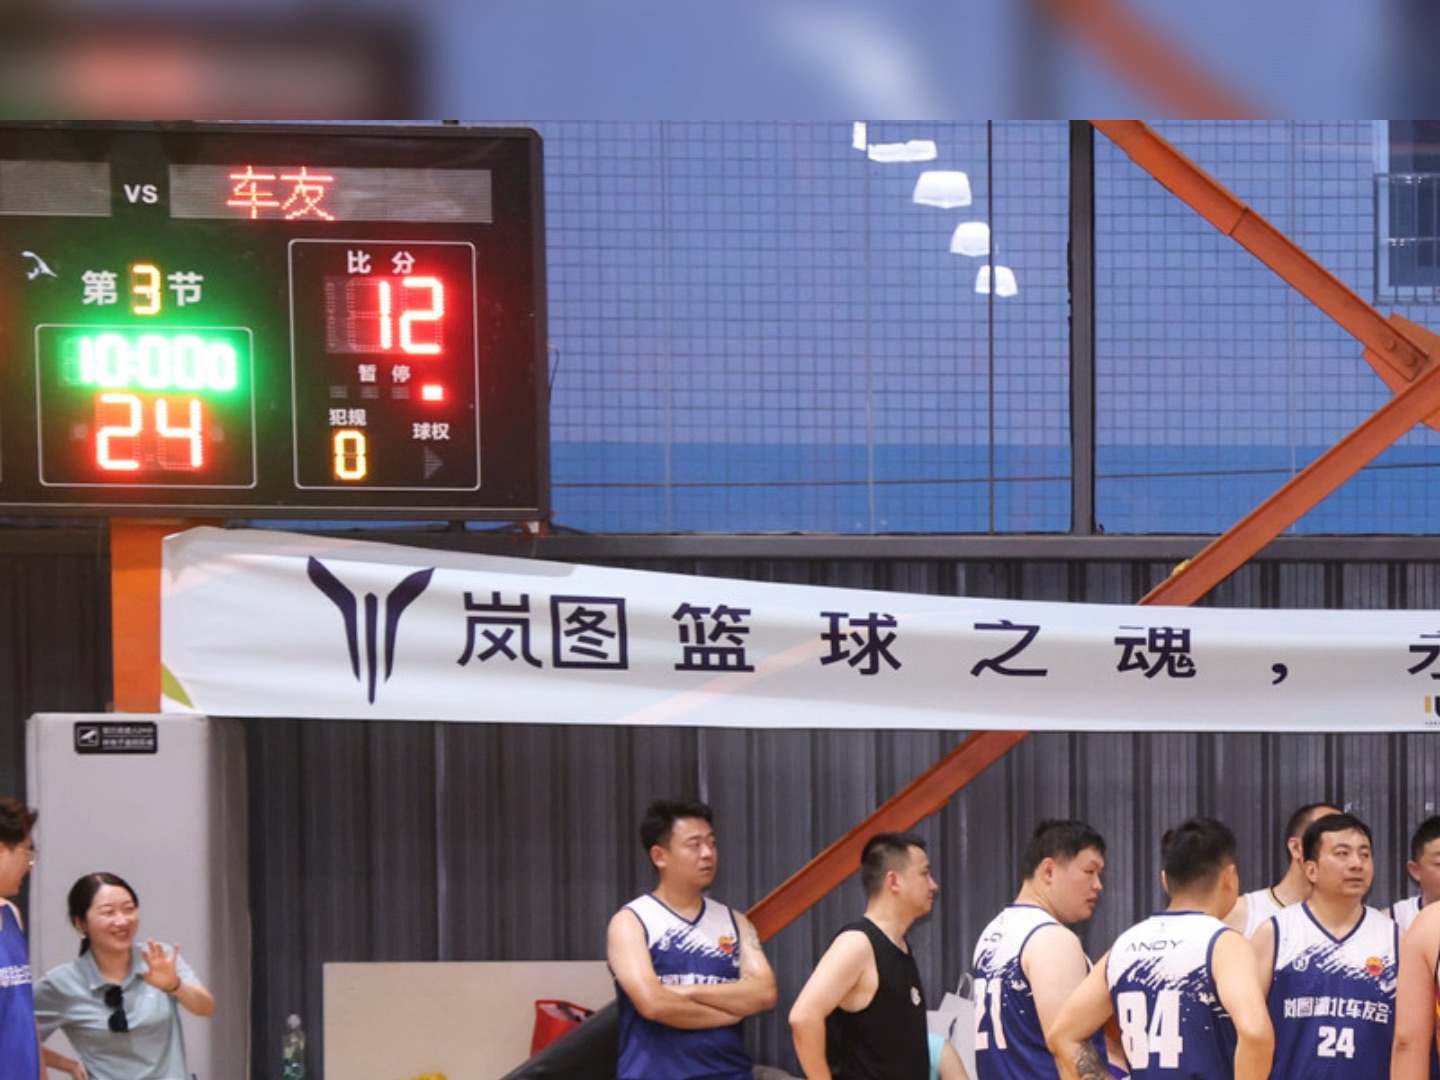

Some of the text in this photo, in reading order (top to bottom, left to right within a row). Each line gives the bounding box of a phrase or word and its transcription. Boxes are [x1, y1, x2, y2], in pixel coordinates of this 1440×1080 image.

[123, 184, 159, 205] VS
[226, 166, 335, 221] 车友
[345, 250, 416, 275] 比分
[377, 277, 445, 354] 12
[357, 364, 412, 383] 暂停
[328, 408, 367, 427] 犯规
[412, 422, 450, 441] 球权
[96, 394, 202, 471] 24
[333, 429, 367, 481] 0
[1124, 938, 1185, 953] ANDY
[1117, 989, 1184, 1070] 84
[1316, 1025, 1356, 1059] 24
